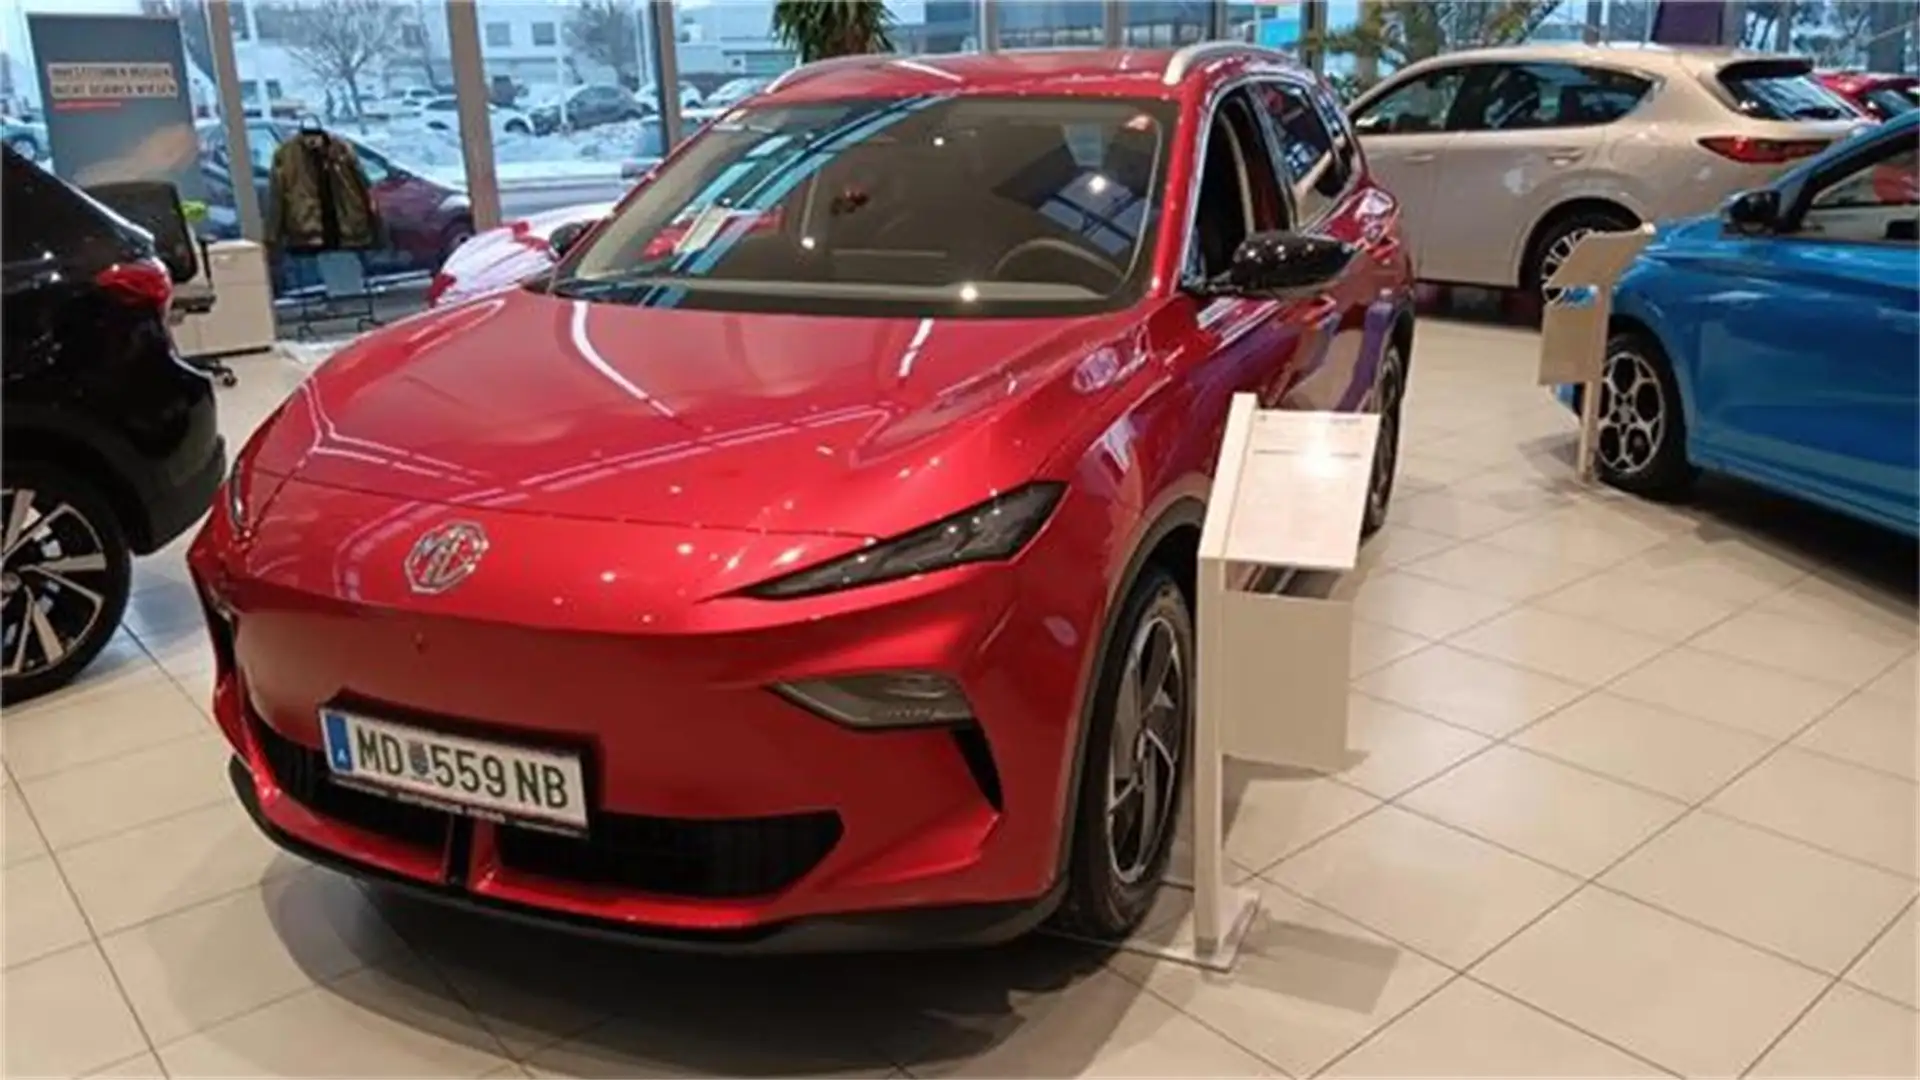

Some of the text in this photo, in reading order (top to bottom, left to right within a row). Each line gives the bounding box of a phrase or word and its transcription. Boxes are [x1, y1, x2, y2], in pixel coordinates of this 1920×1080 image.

[410, 525, 483, 587] MG
[336, 748, 348, 762] A
[356, 726, 404, 776] MD
[430, 745, 507, 798] 559
[514, 760, 569, 809] NB
